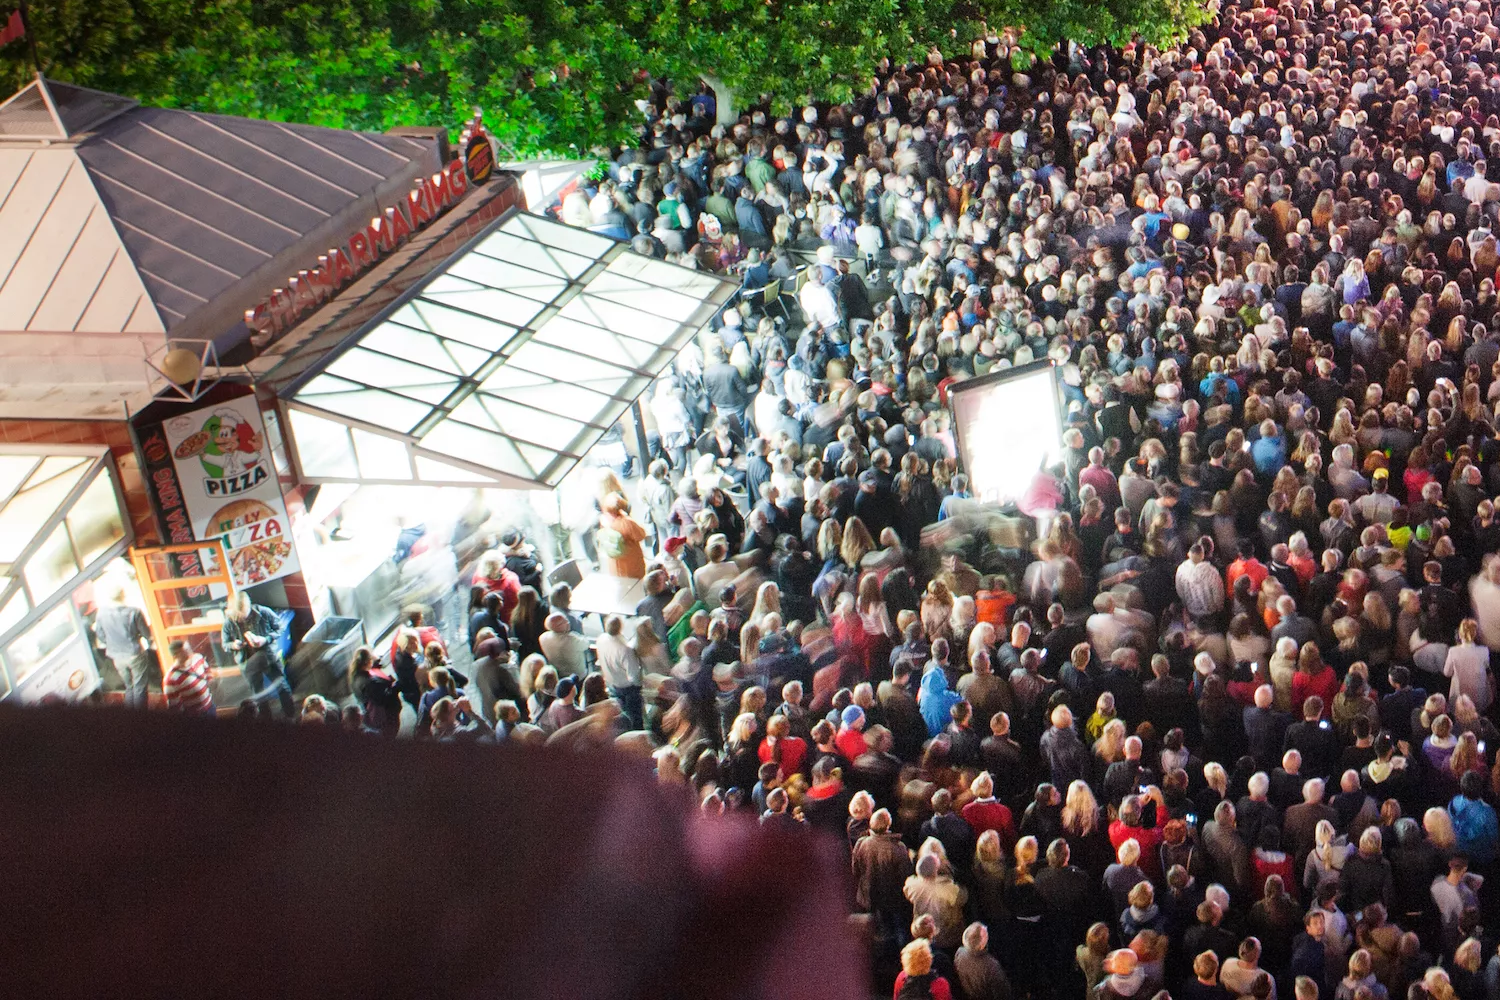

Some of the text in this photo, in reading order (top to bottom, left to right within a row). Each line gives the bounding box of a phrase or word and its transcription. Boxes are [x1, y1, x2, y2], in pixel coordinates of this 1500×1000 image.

[247, 158, 468, 349] SHAWARMA KING
[206, 467, 268, 496] PIZZA
[153, 466, 207, 599] SAWRMA KING
[209, 518, 281, 555] IZZA
[219, 510, 260, 532] ITALY
